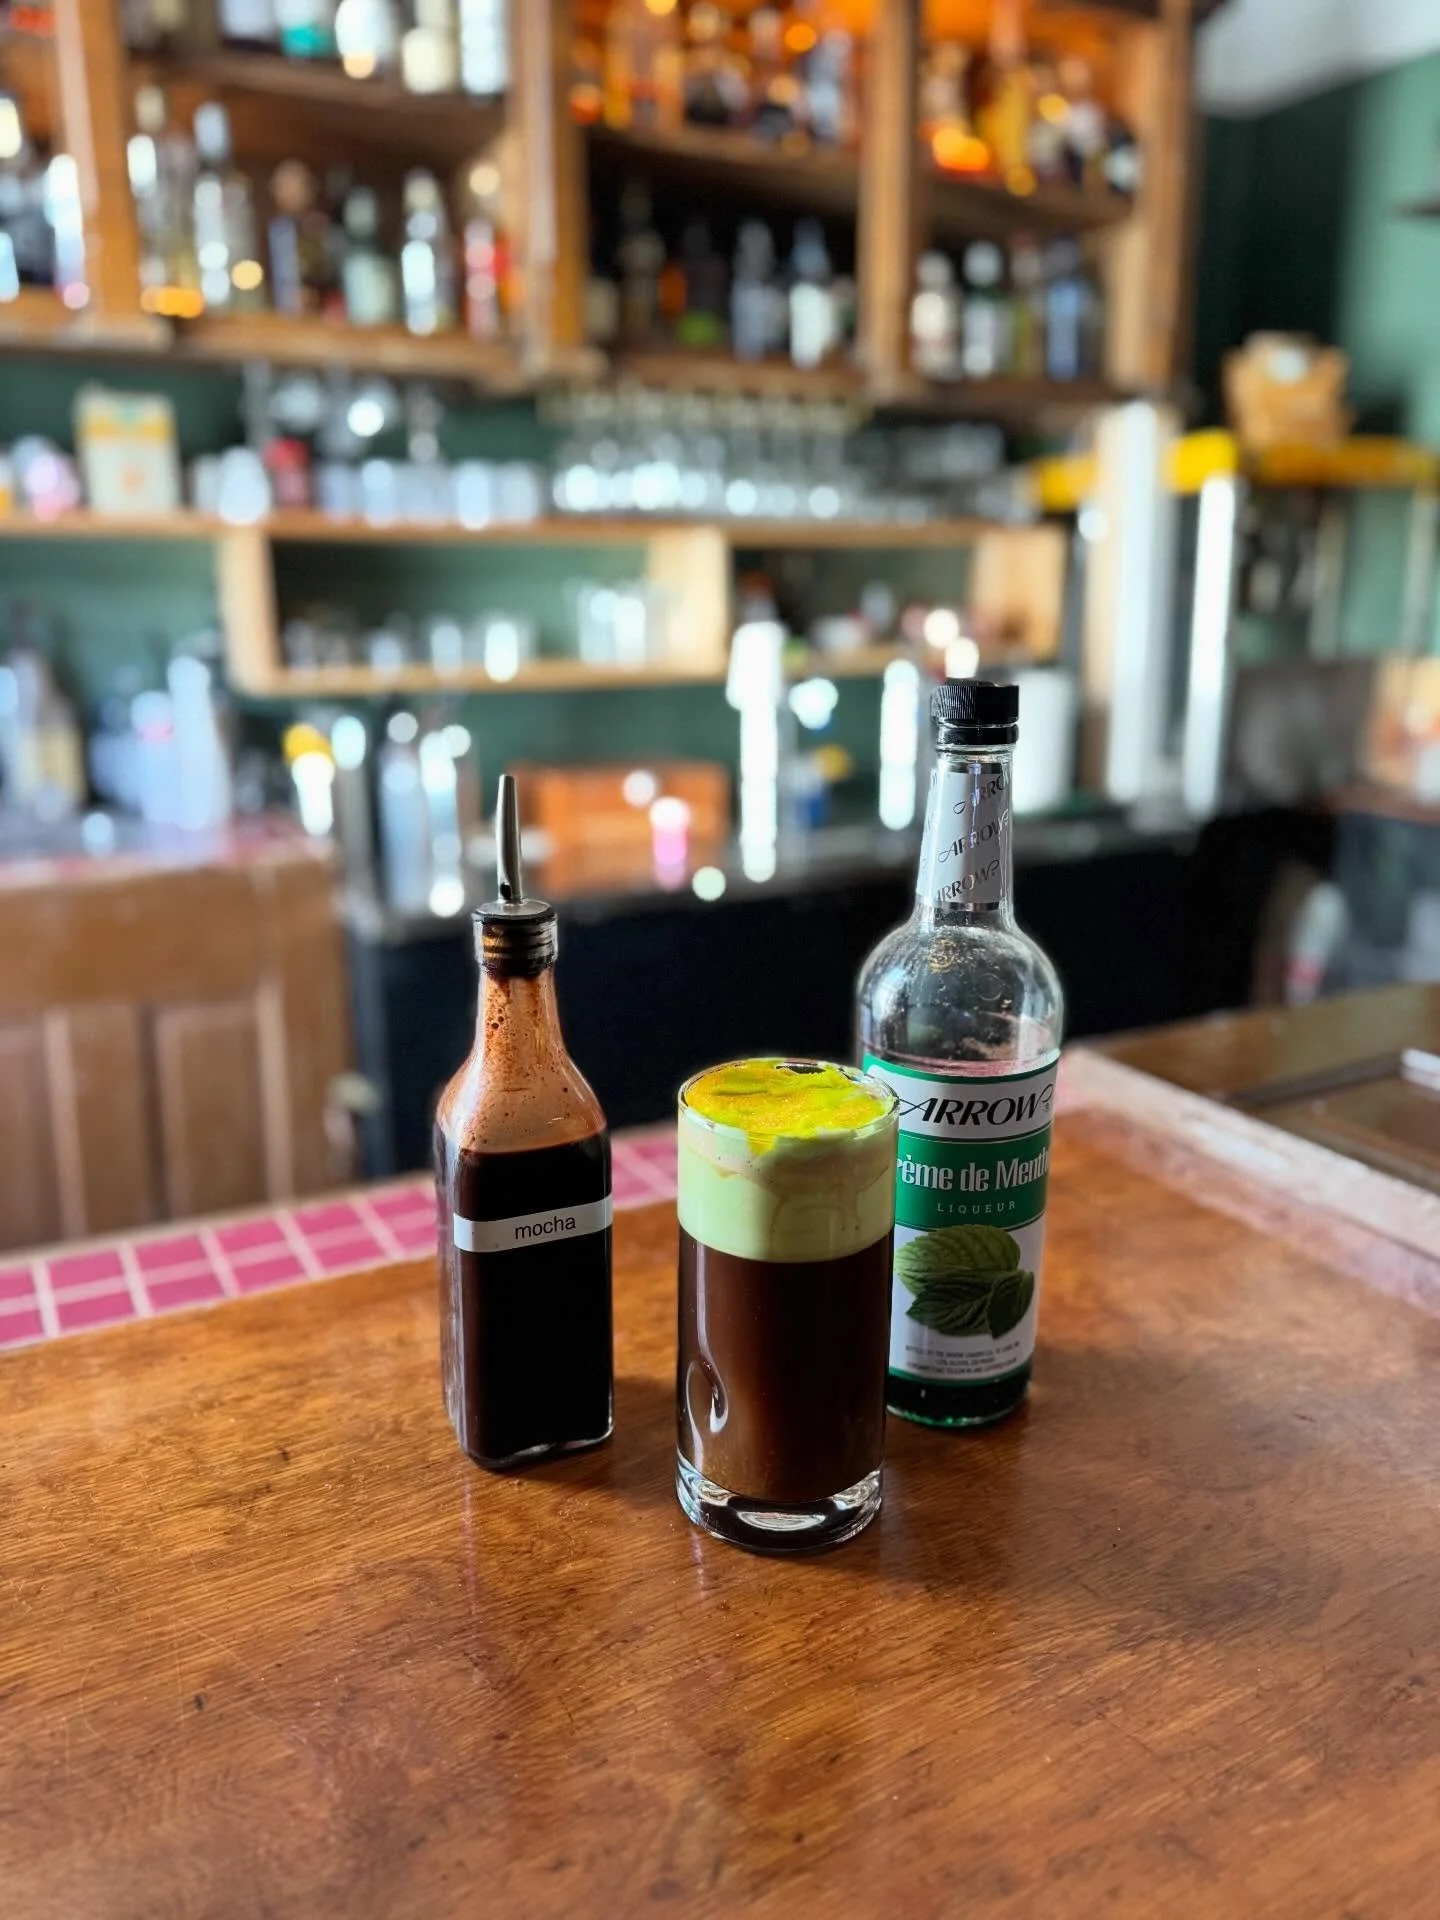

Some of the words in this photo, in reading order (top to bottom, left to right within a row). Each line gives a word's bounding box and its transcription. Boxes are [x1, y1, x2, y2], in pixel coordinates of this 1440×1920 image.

[898, 1083, 1054, 1126] ARROW
[959, 1162, 990, 1192] de
[937, 1200, 1015, 1215] LIQUEUR
[515, 1216, 576, 1239] mocha
